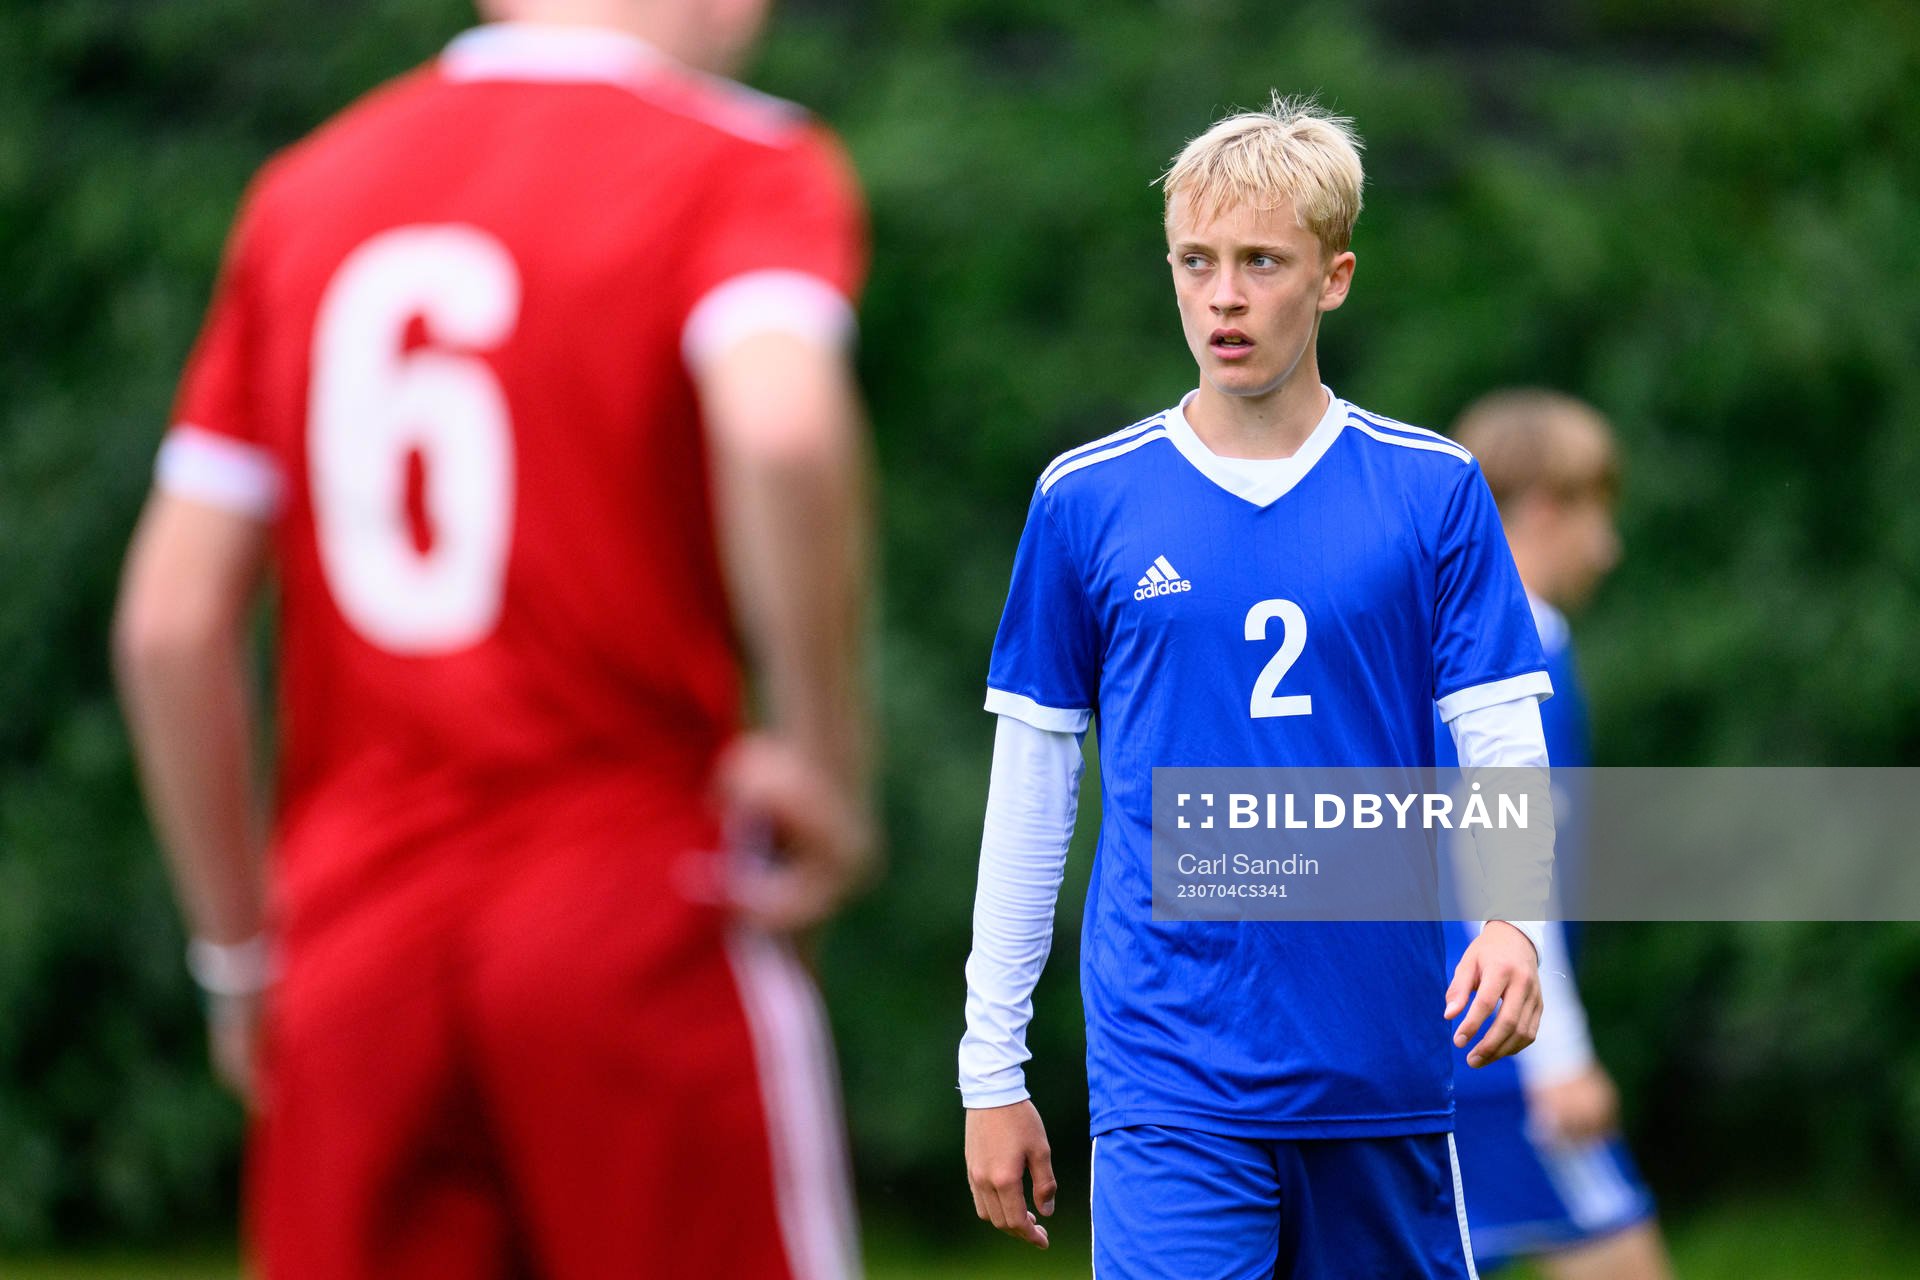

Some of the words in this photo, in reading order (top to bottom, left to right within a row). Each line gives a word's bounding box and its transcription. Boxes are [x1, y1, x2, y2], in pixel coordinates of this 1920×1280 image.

[306, 222, 523, 656] 6
[1134, 579, 1192, 601] adidas
[1244, 598, 1313, 719] 2
